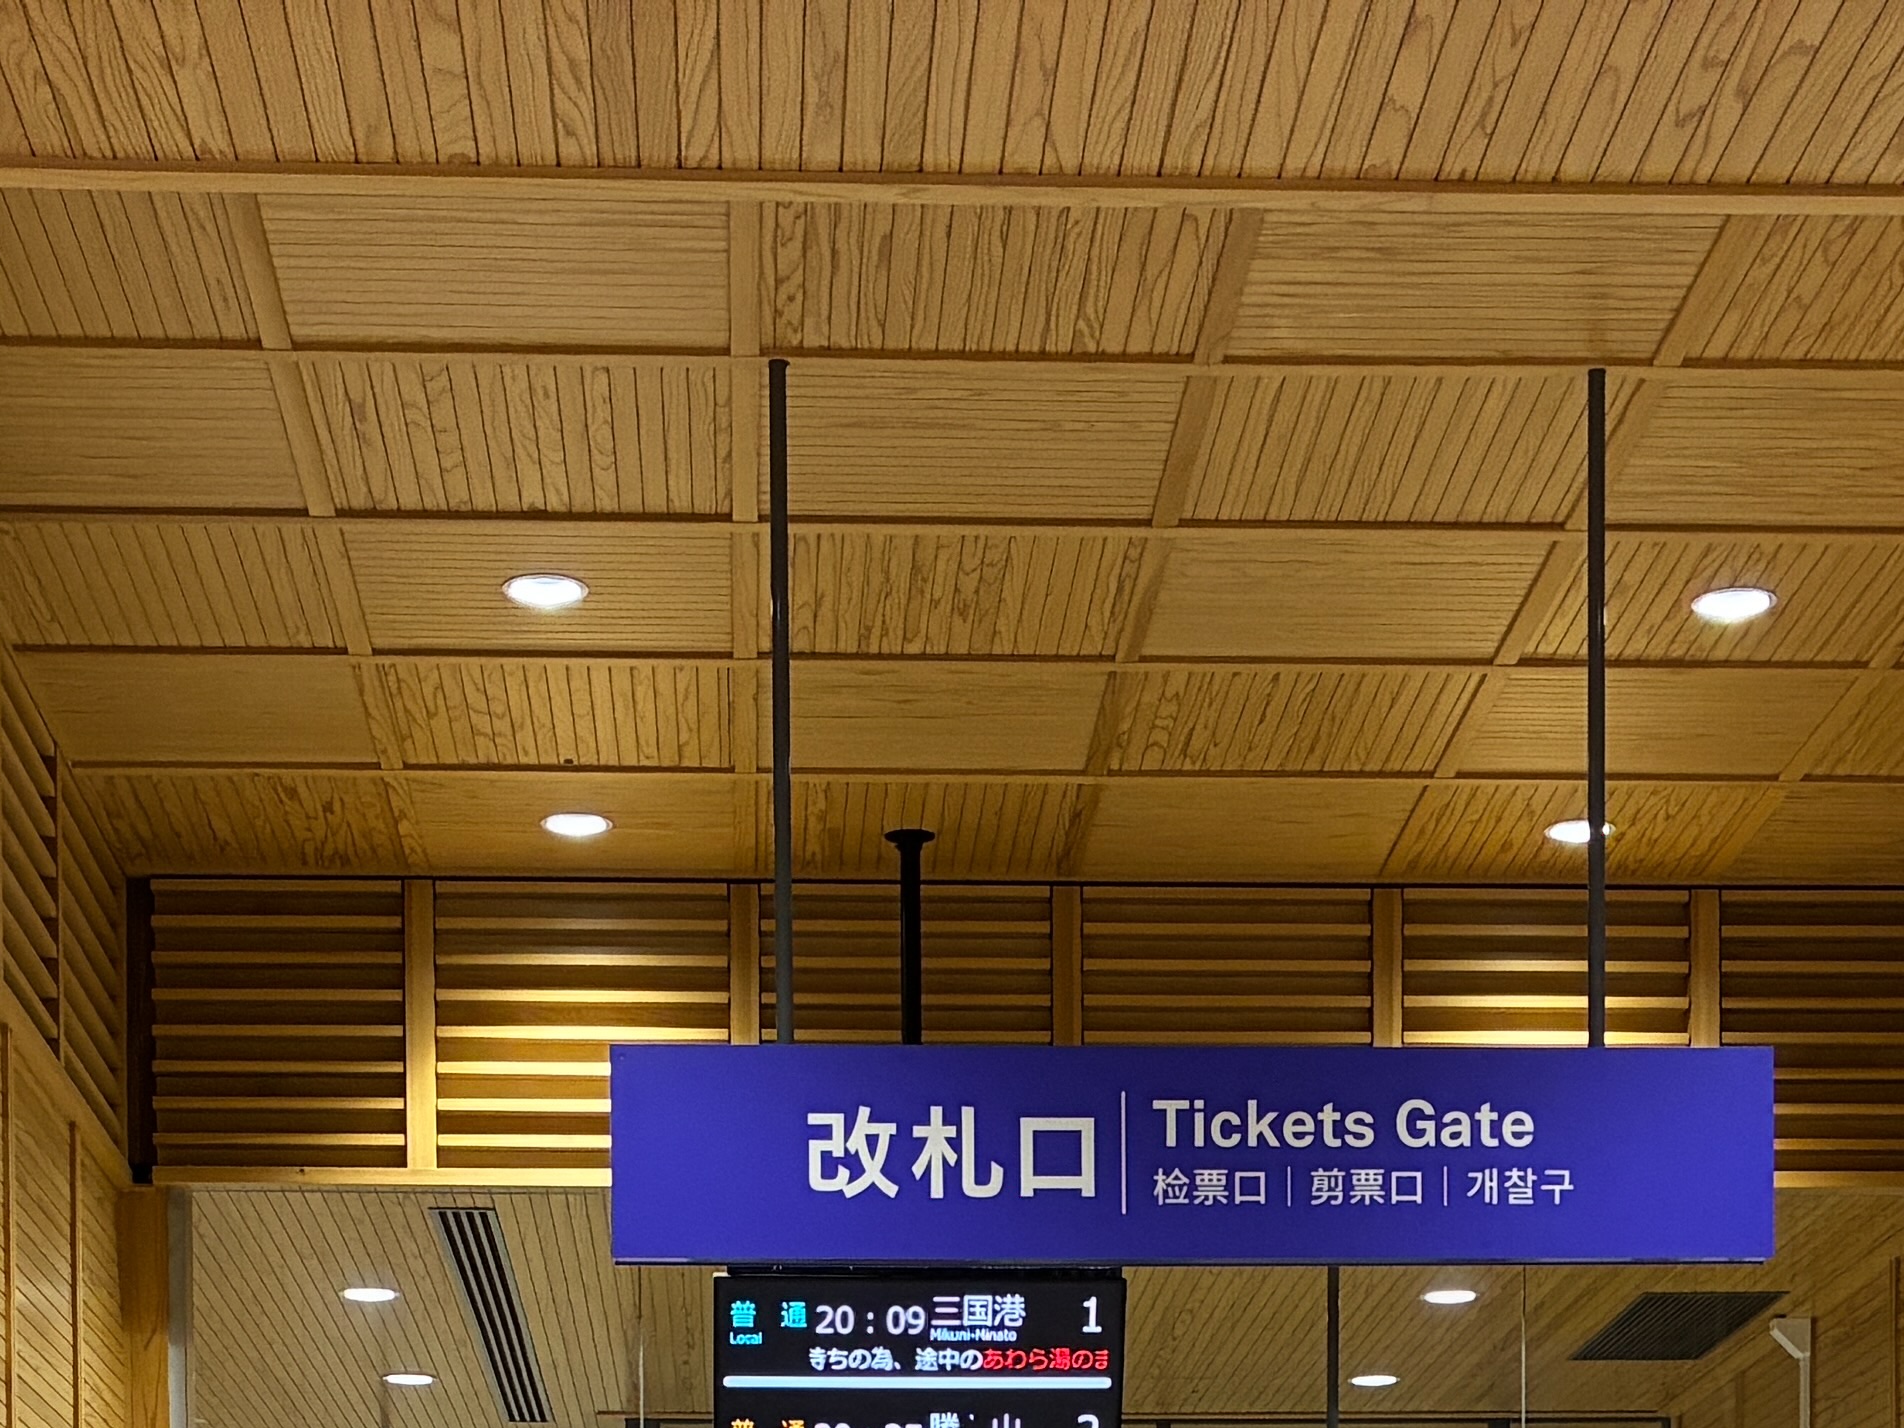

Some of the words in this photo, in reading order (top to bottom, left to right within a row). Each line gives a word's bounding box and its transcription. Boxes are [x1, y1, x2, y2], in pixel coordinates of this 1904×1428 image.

[805, 1104, 1096, 1202] 改札口
[1153, 1098, 1377, 1149] Tickets
[1394, 1098, 1534, 1149] Gate
[1152, 1168, 1267, 1206] 检票口
[1309, 1167, 1424, 1206] 剪票口
[1465, 1167, 1576, 1208] 개찰구
[815, 1305, 927, 1336] 20:09
[930, 1294, 1026, 1328] 三国港
[1081, 1296, 1104, 1333] 1
[729, 1331, 763, 1346] Local
